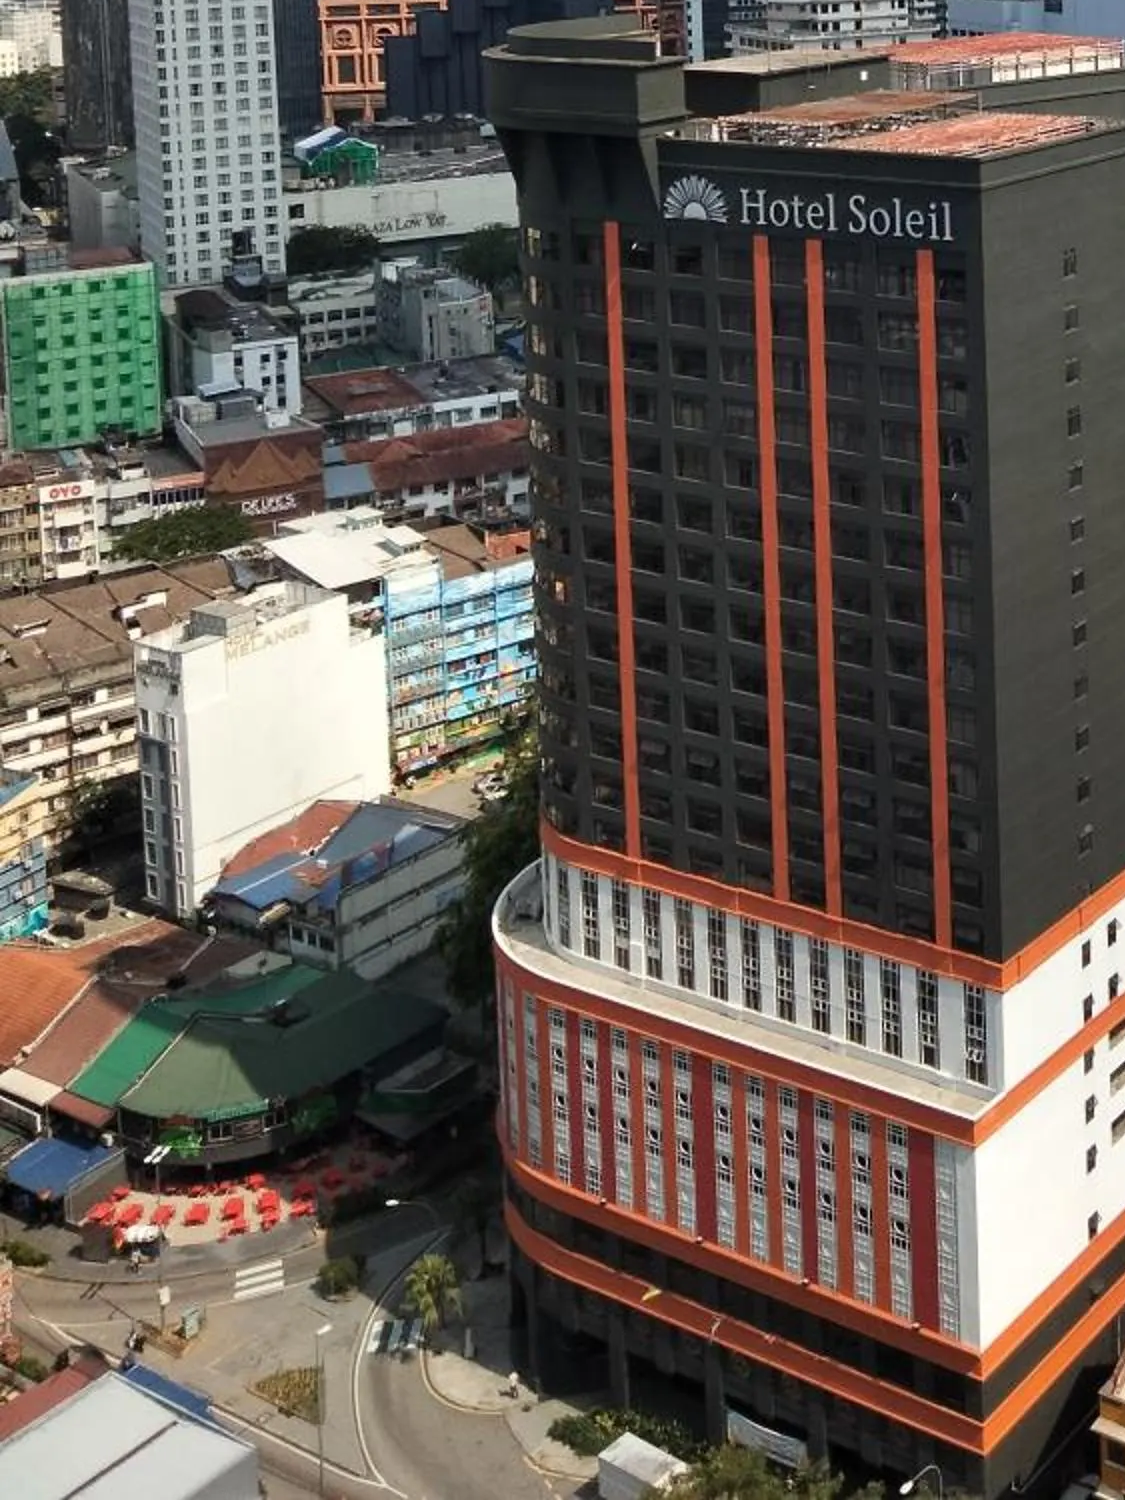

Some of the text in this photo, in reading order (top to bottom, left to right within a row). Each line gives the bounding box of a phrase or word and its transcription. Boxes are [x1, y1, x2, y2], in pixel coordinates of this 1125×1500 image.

[739, 187, 953, 241] Hotel Soleil
[49, 485, 81, 499] OYO
